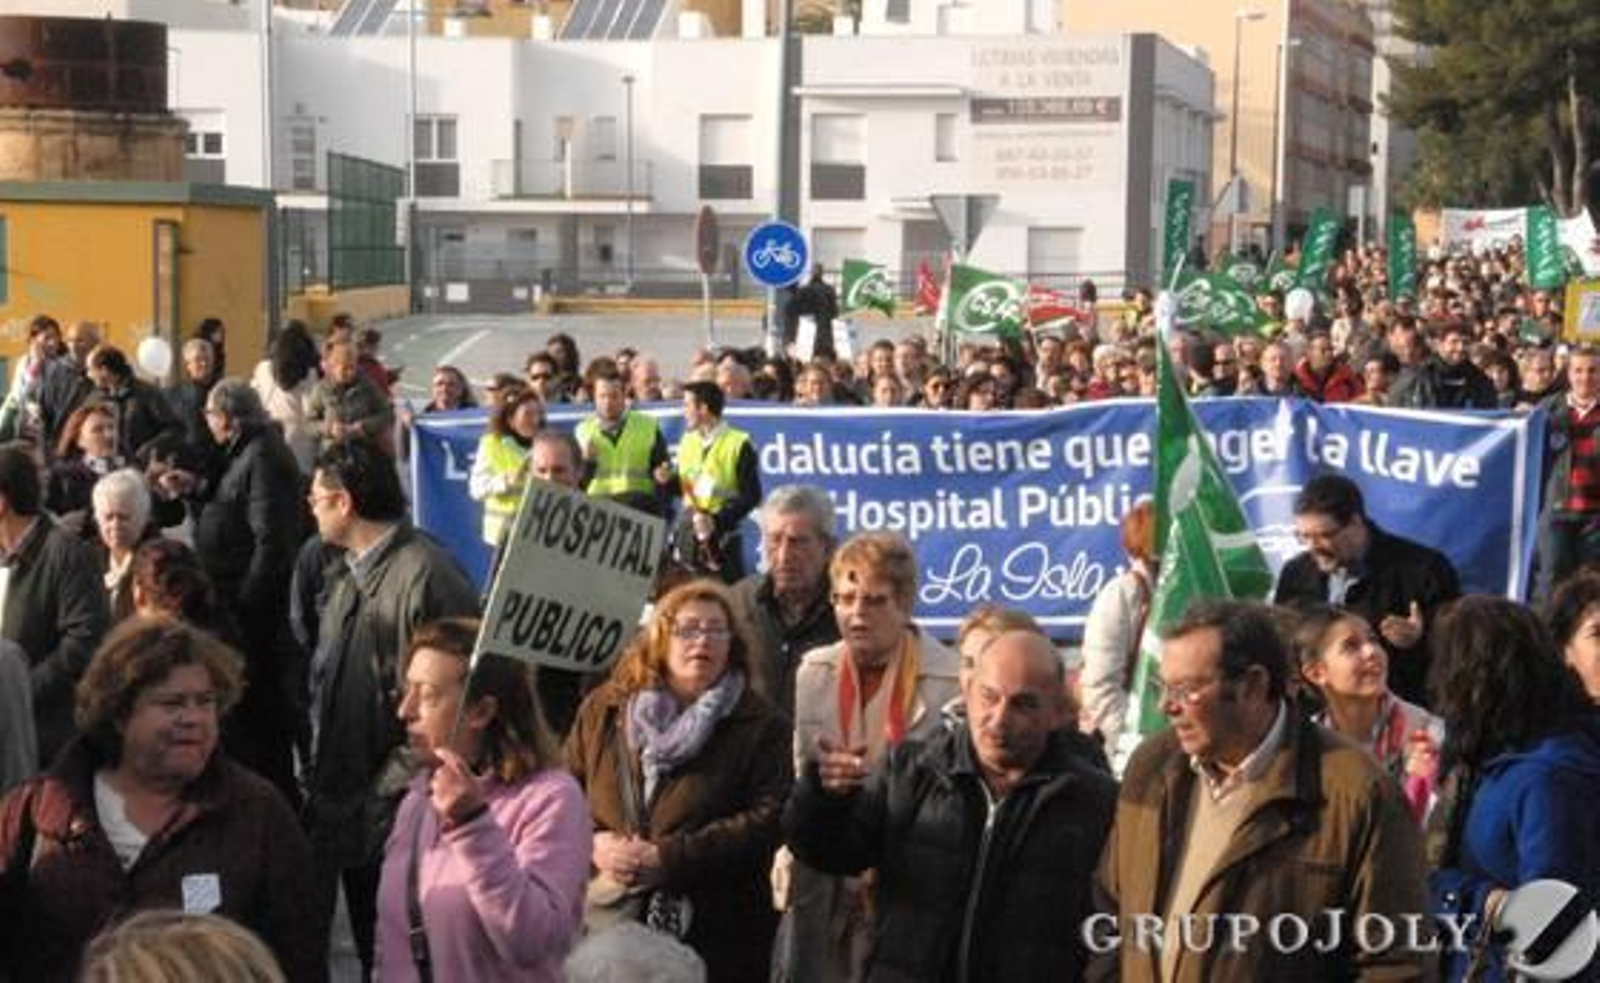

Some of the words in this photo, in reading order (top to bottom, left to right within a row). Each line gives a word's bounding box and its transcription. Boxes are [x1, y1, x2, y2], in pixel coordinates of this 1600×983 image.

[758, 431, 922, 474] dalucía
[930, 431, 1052, 473] tiene
[1064, 432, 1151, 479] que
[1307, 416, 1349, 468] la
[1360, 430, 1481, 489] llave
[522, 490, 655, 578] HOSPITAL
[828, 485, 1008, 540] Hospital
[1018, 484, 1154, 529] Públi
[919, 543, 992, 604] La
[1001, 541, 1105, 601] Isla
[492, 590, 623, 666] PUBLICO
